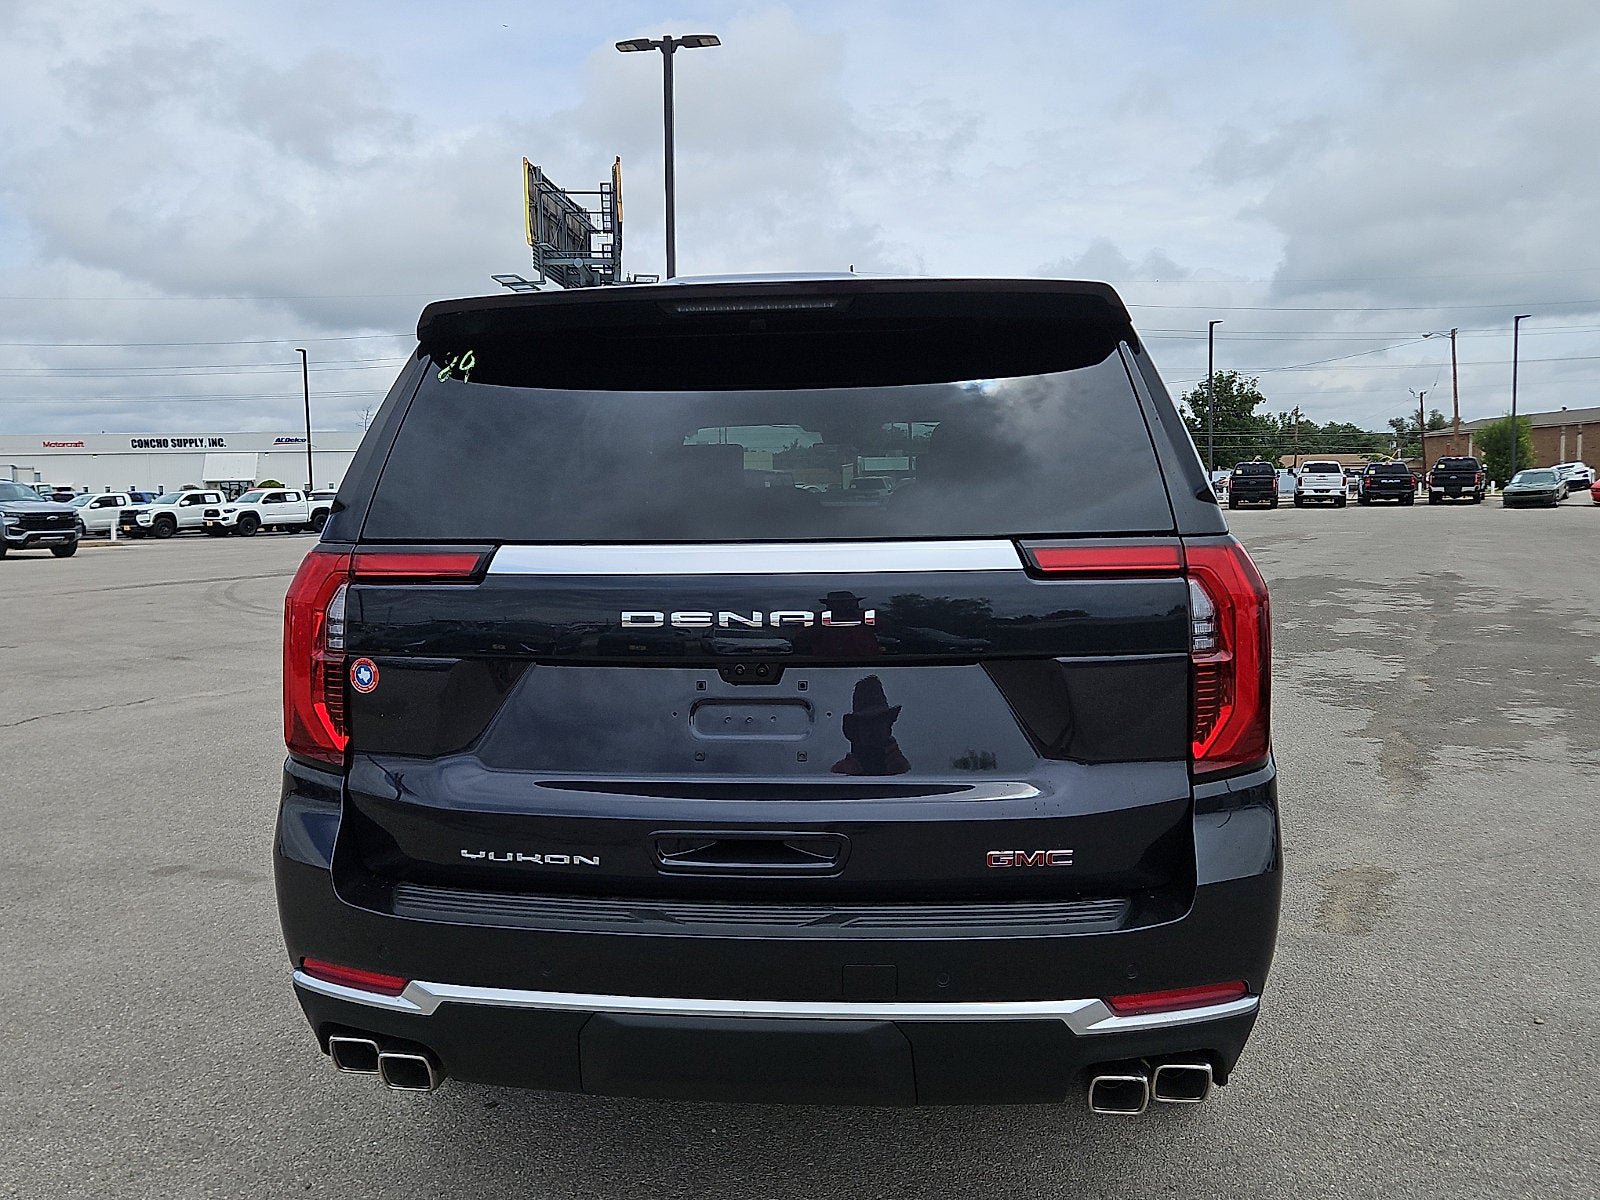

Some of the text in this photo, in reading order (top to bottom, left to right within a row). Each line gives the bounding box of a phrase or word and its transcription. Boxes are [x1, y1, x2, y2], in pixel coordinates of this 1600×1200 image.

[130, 437, 227, 449] CONCHO SUPPLY, INC.
[621, 609, 876, 628] DENALI
[460, 849, 600, 866] YUKON
[986, 849, 1074, 868] GMC
